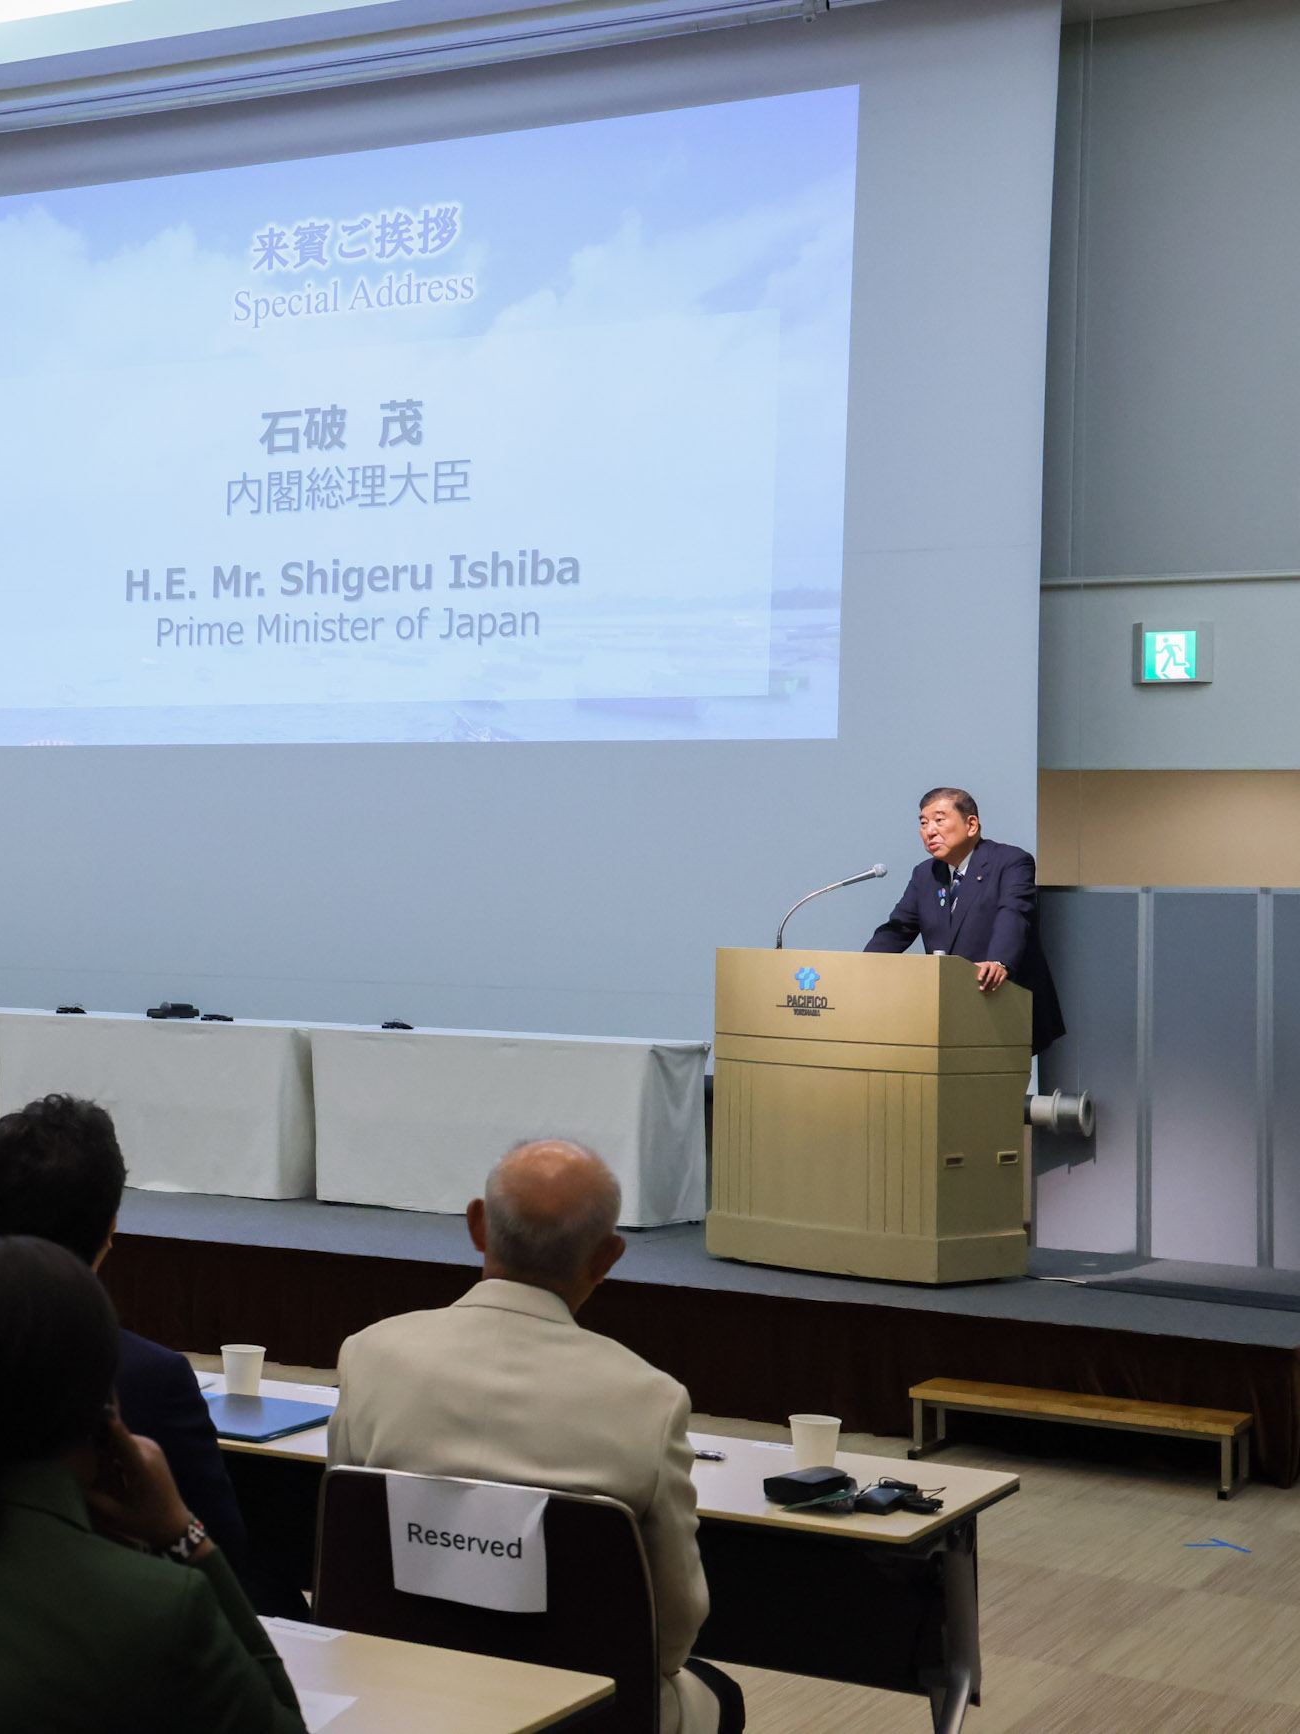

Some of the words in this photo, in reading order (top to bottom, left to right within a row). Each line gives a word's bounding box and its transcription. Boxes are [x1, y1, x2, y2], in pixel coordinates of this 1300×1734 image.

[252, 205, 459, 272] 来賓ご挨拶
[234, 279, 341, 329] Special
[348, 272, 475, 311] Address
[259, 403, 347, 455] 石破
[377, 398, 424, 449] 茂
[226, 459, 472, 517] 内閣総理大臣
[125, 566, 197, 602] H.E.
[212, 564, 266, 599] Mr.
[280, 558, 433, 602] Shigeru
[448, 549, 580, 589] Ishiba
[156, 615, 245, 648] Prime
[257, 611, 386, 645] Minister
[395, 606, 431, 640] of
[439, 607, 541, 647] Japan
[786, 994, 828, 1009] PACIFICO
[407, 1522, 523, 1560] Reserved
